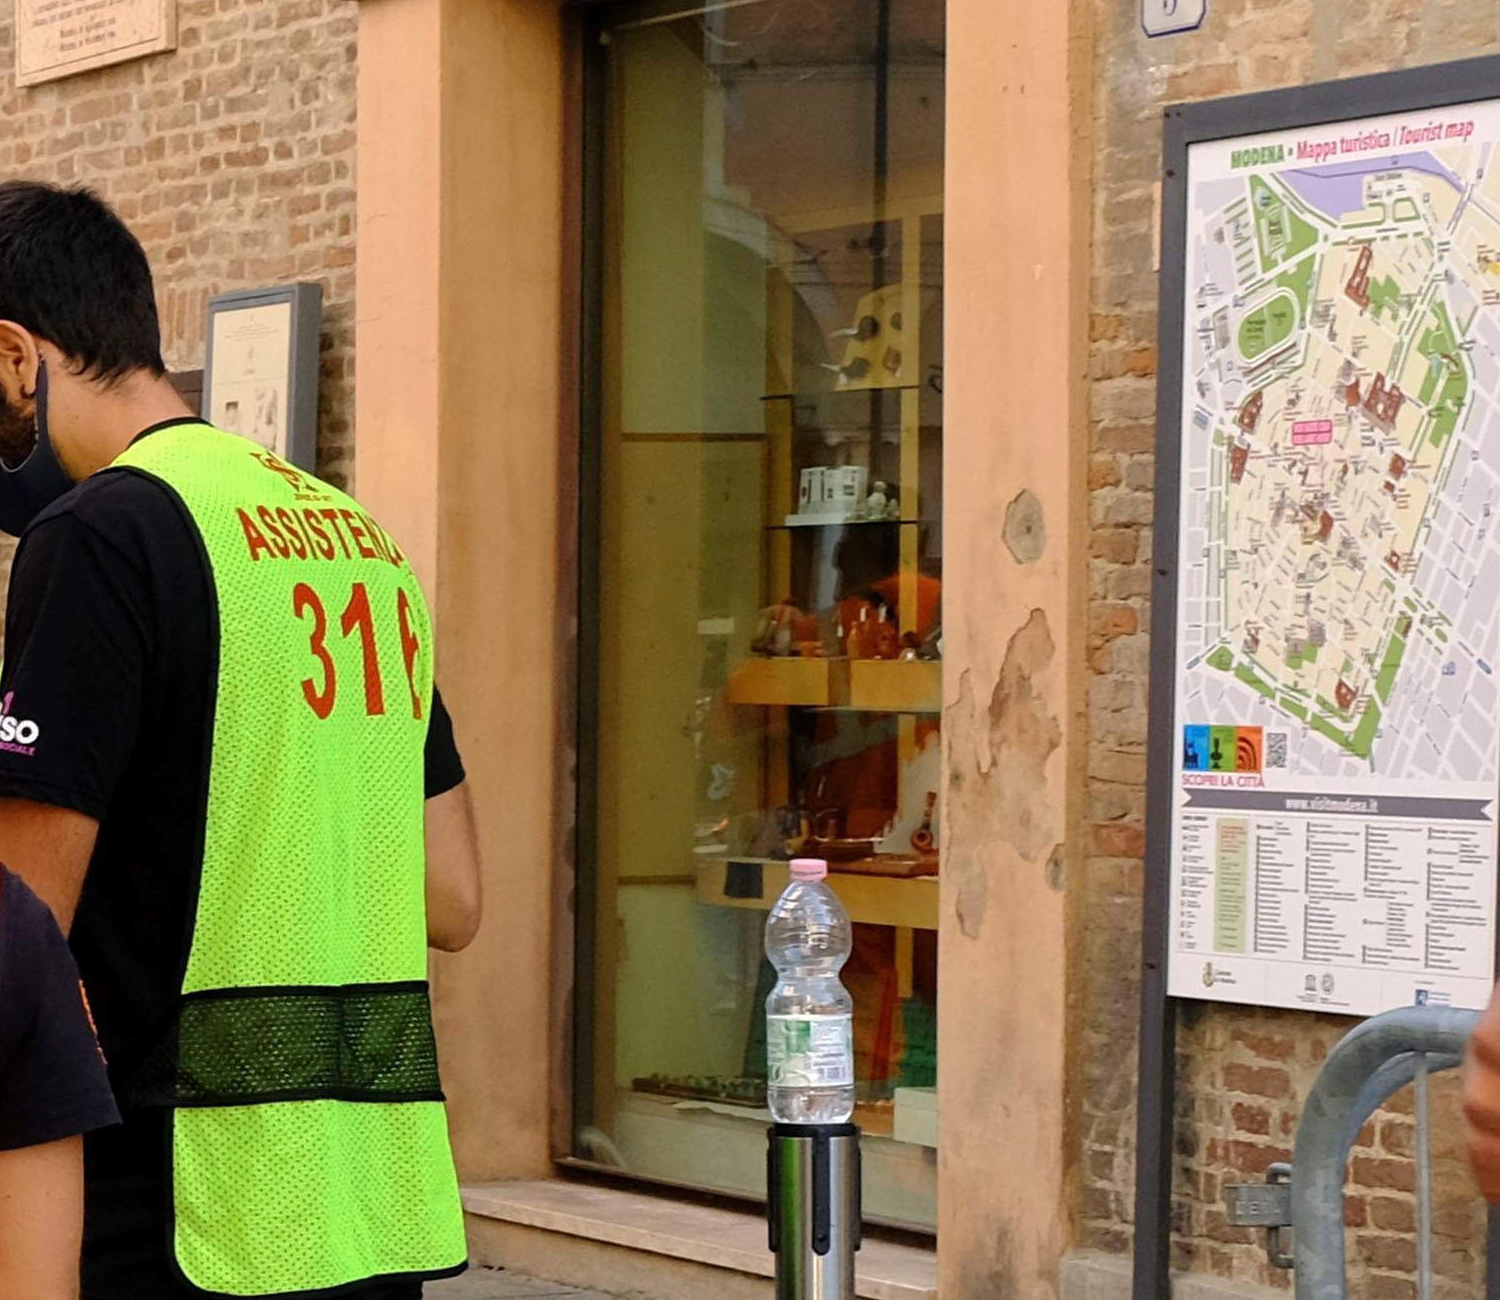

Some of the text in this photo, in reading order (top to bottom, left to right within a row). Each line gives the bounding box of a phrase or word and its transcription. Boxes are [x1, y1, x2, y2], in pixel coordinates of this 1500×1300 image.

[1231, 120, 1475, 169] MODENA Mappa turistica Tourist map
[236, 506, 405, 568] ASSISTENZ
[1182, 773, 1219, 787] SCOPRI
[1221, 774, 1233, 788] LA
